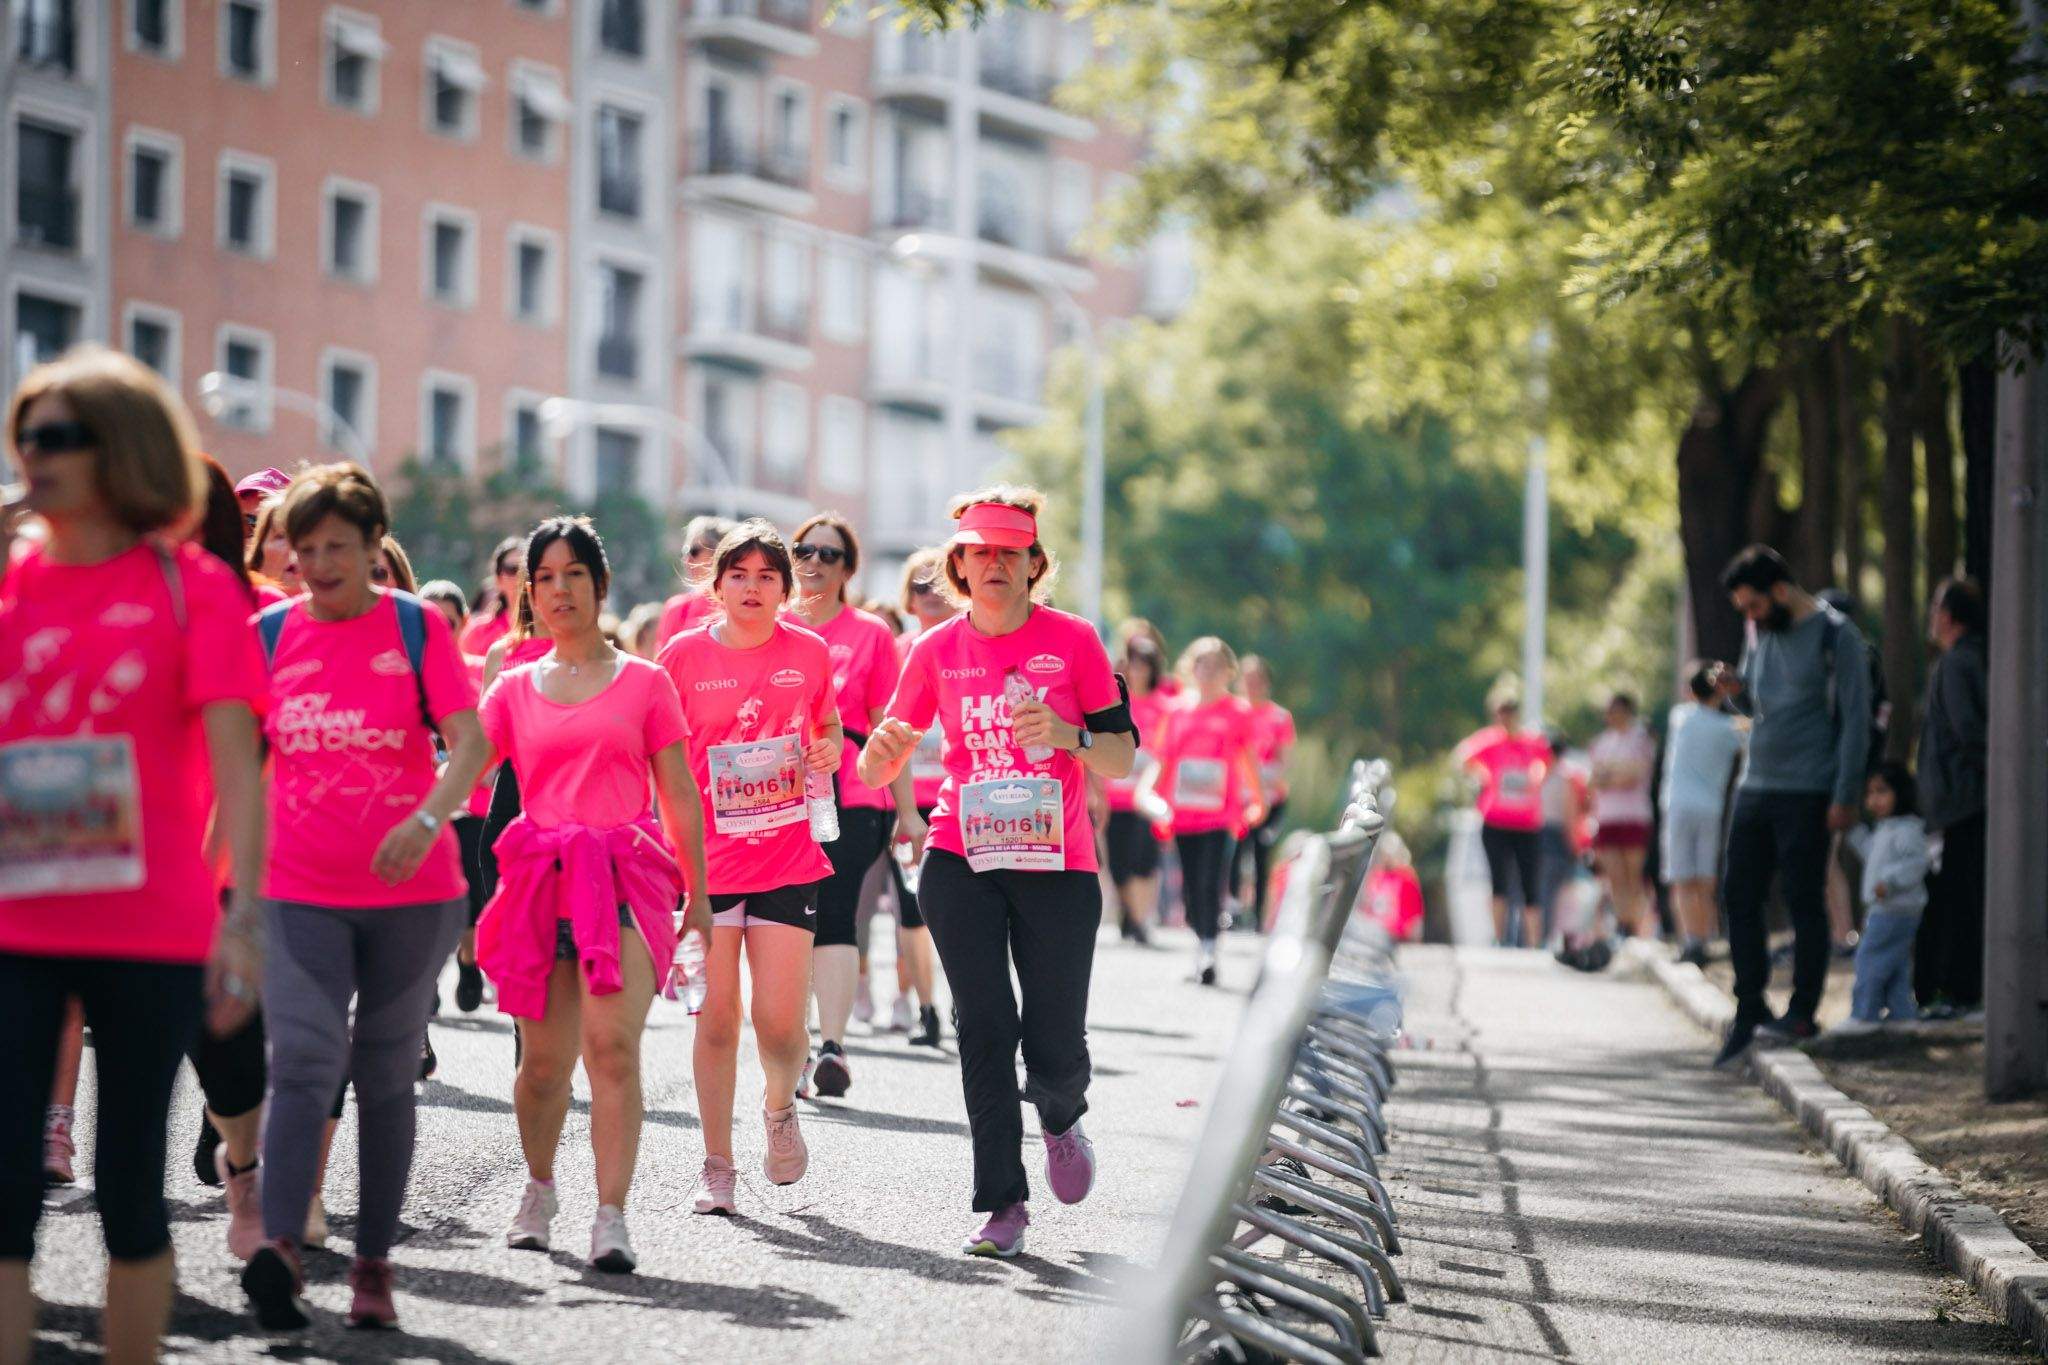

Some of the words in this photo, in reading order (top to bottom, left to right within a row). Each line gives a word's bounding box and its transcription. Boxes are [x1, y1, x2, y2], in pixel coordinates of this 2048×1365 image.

[942, 667, 986, 679] OYSHO
[695, 679, 738, 692] OYSHO
[971, 749, 1014, 771] LAS
[743, 778, 779, 797] 016
[994, 817, 1032, 834] 016
